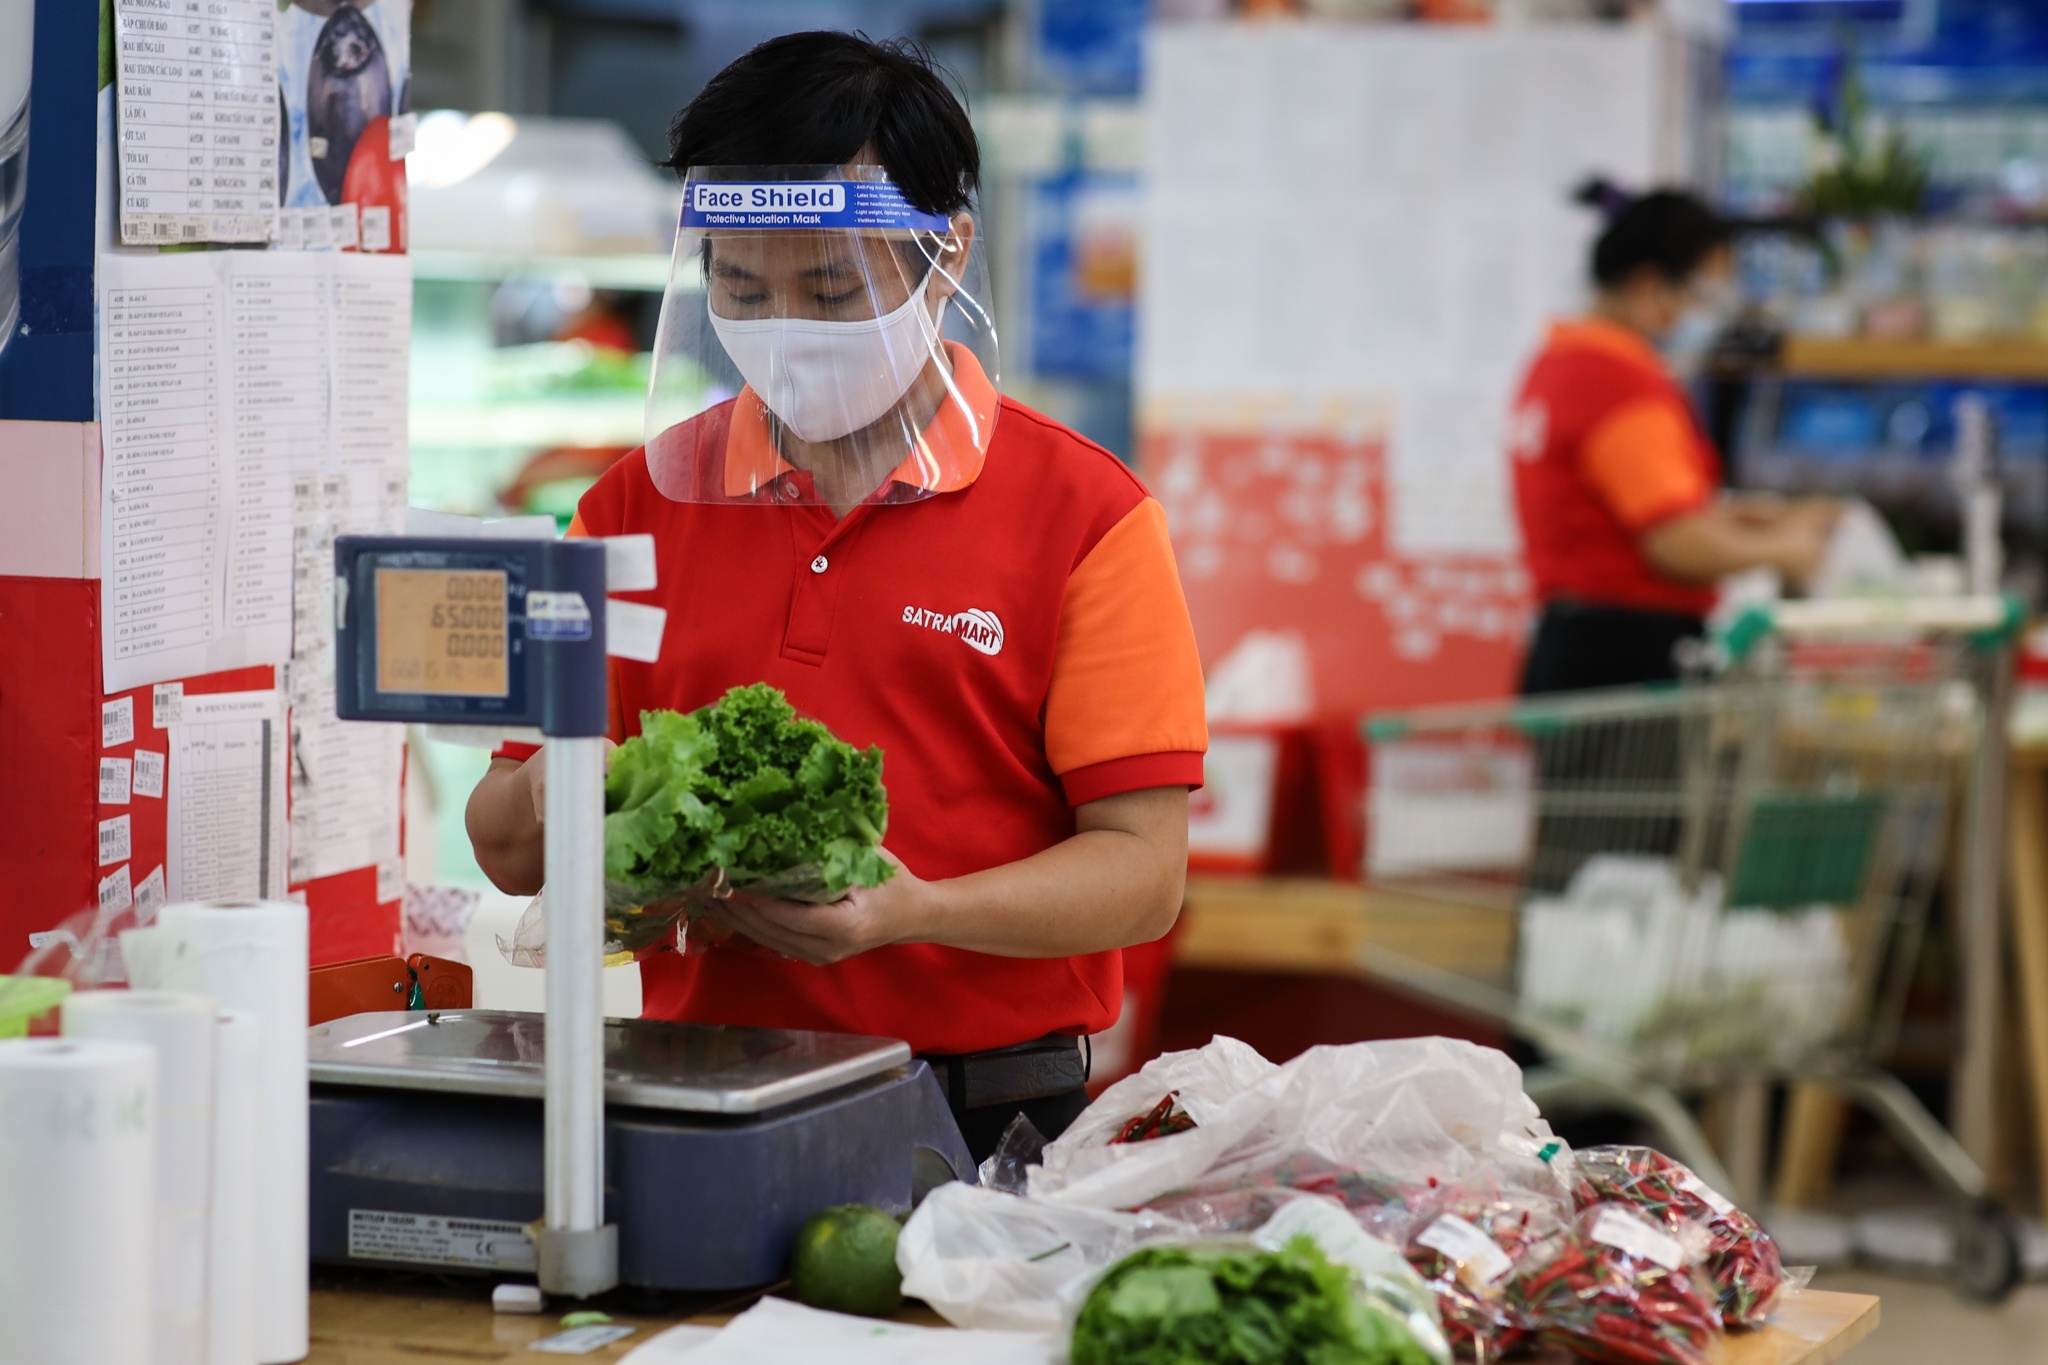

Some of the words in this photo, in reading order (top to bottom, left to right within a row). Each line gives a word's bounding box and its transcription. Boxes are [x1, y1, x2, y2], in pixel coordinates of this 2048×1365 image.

[699, 188, 743, 206] Face
[751, 188, 834, 207] Shield
[706, 214, 746, 224] Protective
[748, 214, 790, 224] Isolation
[793, 214, 821, 224] Mask
